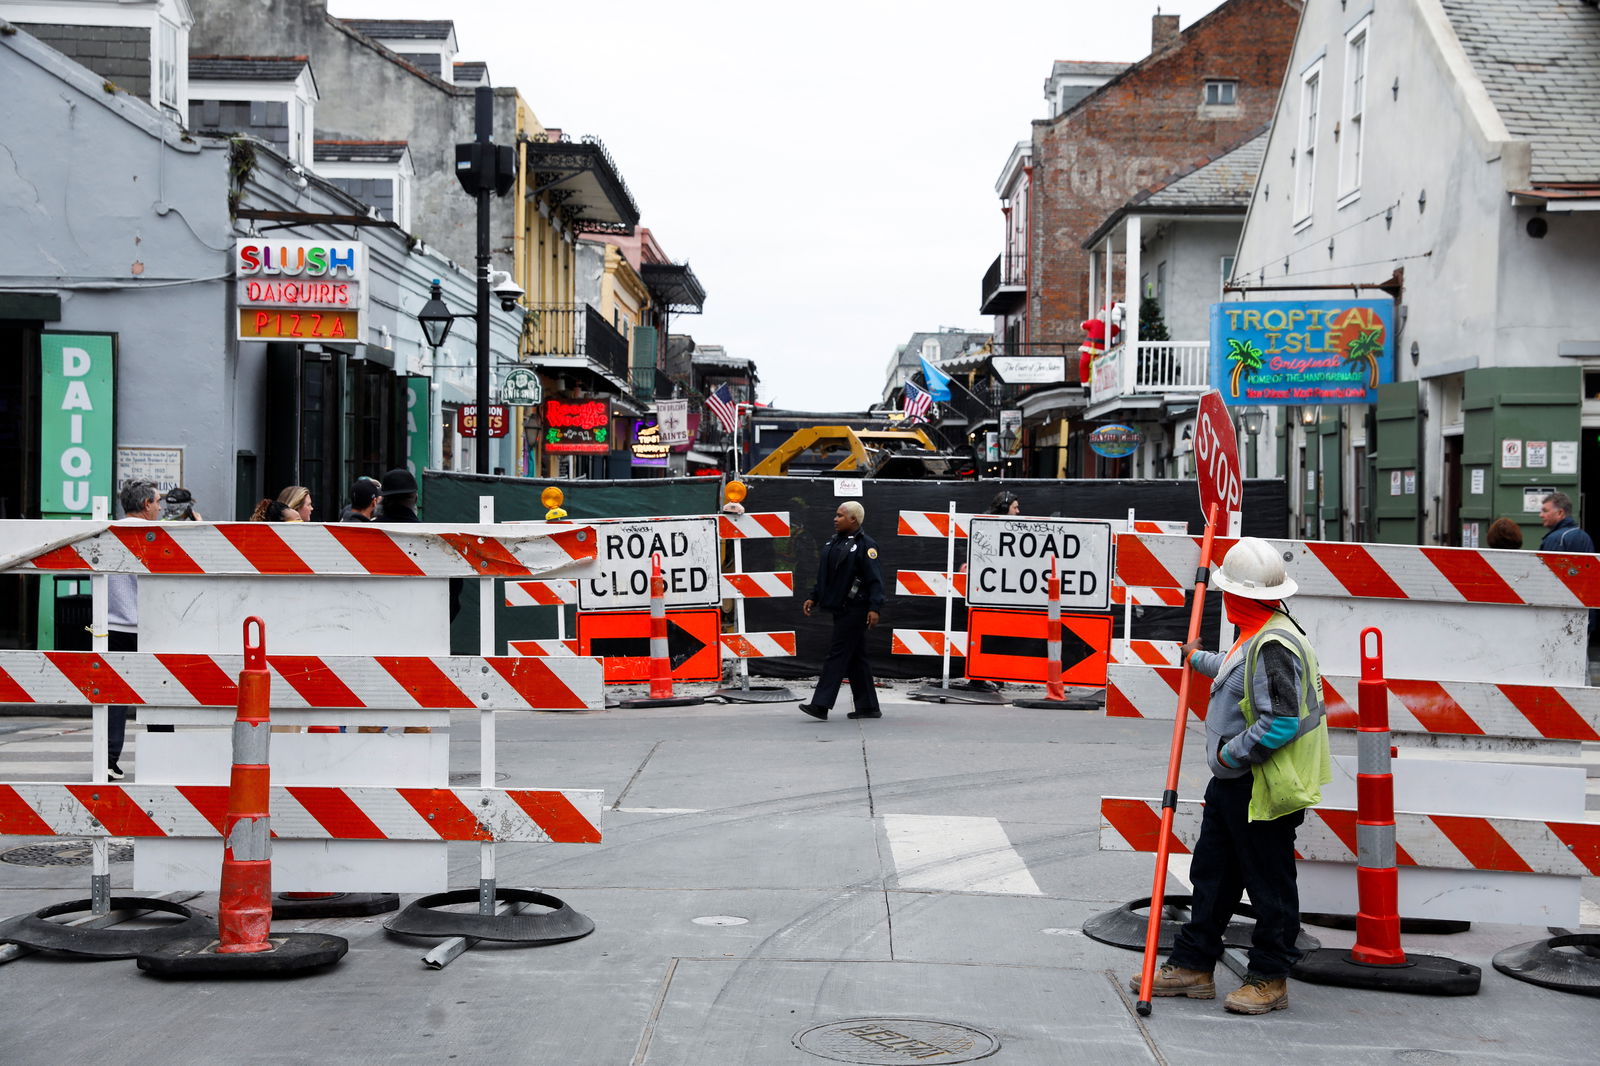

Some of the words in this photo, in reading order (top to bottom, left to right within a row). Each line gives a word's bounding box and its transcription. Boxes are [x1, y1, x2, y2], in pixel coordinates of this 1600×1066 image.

[240, 245, 355, 277] SLUSH
[255, 311, 346, 337] PIZZA
[1225, 307, 1384, 331] TROPICAL
[1264, 332, 1343, 354] ISLE
[1269, 354, 1343, 373] Original
[1248, 374, 1271, 384] HOME
[1272, 374, 1283, 383] OF
[1286, 373, 1301, 382] THE
[463, 407, 503, 416] BOON
[463, 416, 503, 428] GITS
[61, 346, 94, 511] DAIQU
[1198, 412, 1239, 512] STOP
[606, 532, 689, 560] ROAD
[999, 532, 1081, 559] ROAD
